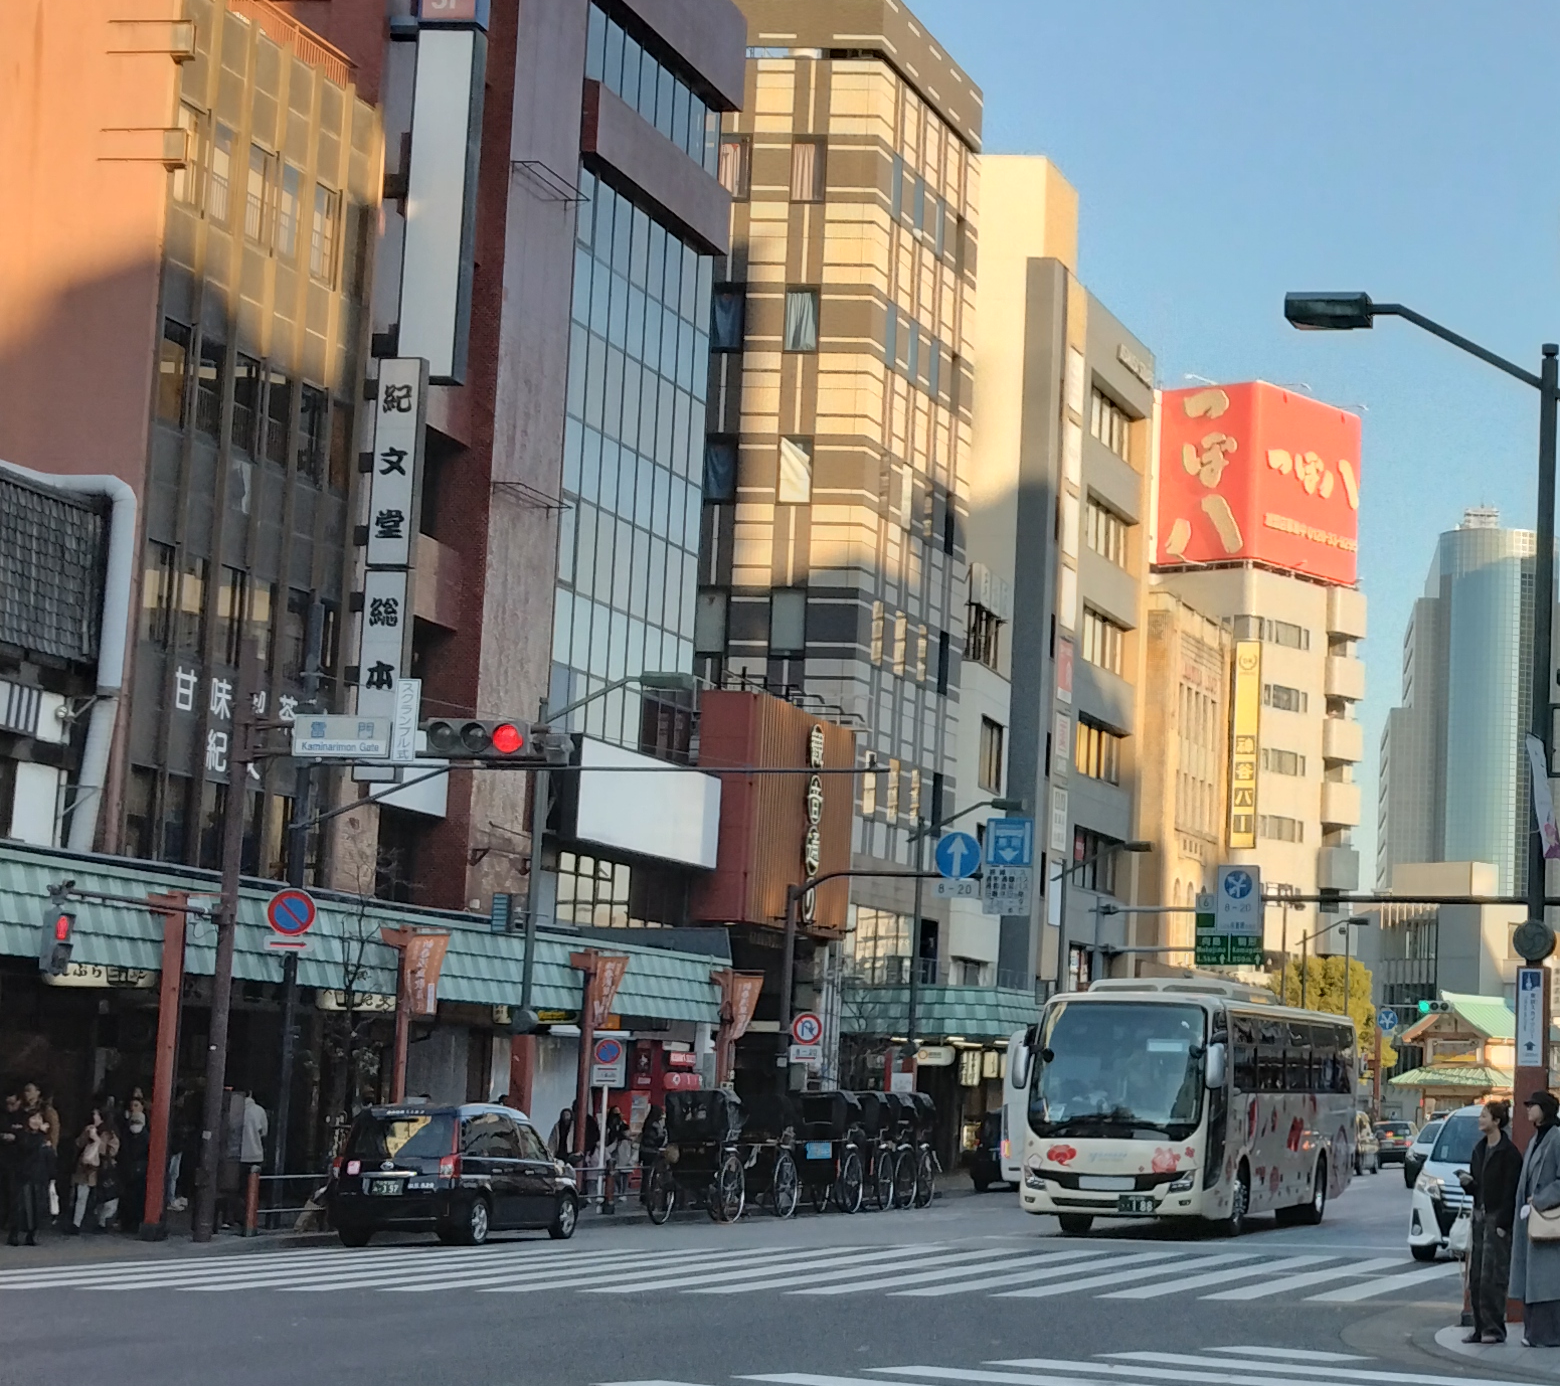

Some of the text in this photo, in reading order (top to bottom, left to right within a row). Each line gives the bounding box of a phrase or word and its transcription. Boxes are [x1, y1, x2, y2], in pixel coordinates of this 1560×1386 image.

[1164, 388, 1243, 554] つぼ八
[1265, 448, 1359, 511] つぼ八
[302, 741, 379, 753] Kaminarimon Gate
[311, 721, 375, 740] 雷門
[1234, 735, 1255, 833] 神谷バー
